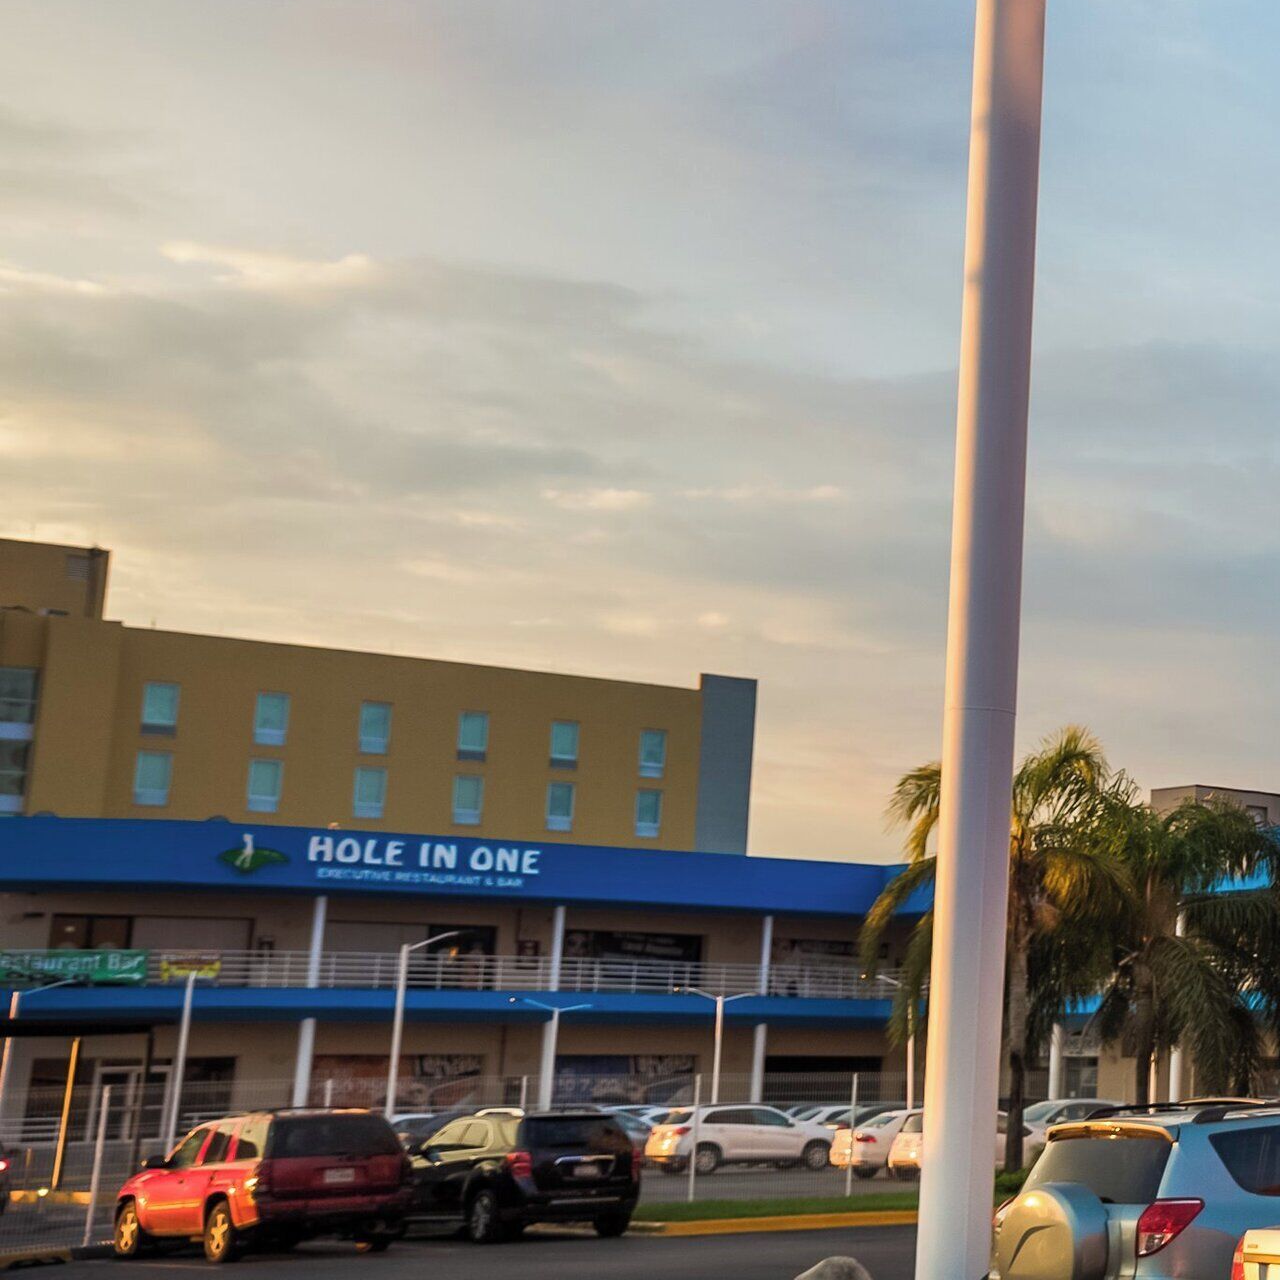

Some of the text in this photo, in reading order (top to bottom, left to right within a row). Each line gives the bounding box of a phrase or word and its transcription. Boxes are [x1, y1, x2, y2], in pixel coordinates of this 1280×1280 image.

[307, 835, 541, 875] HOLE IN ONE
[316, 868, 390, 883] EXECUTIVE
[394, 871, 481, 887] RESTAURANT
[0, 953, 102, 971] estaurant
